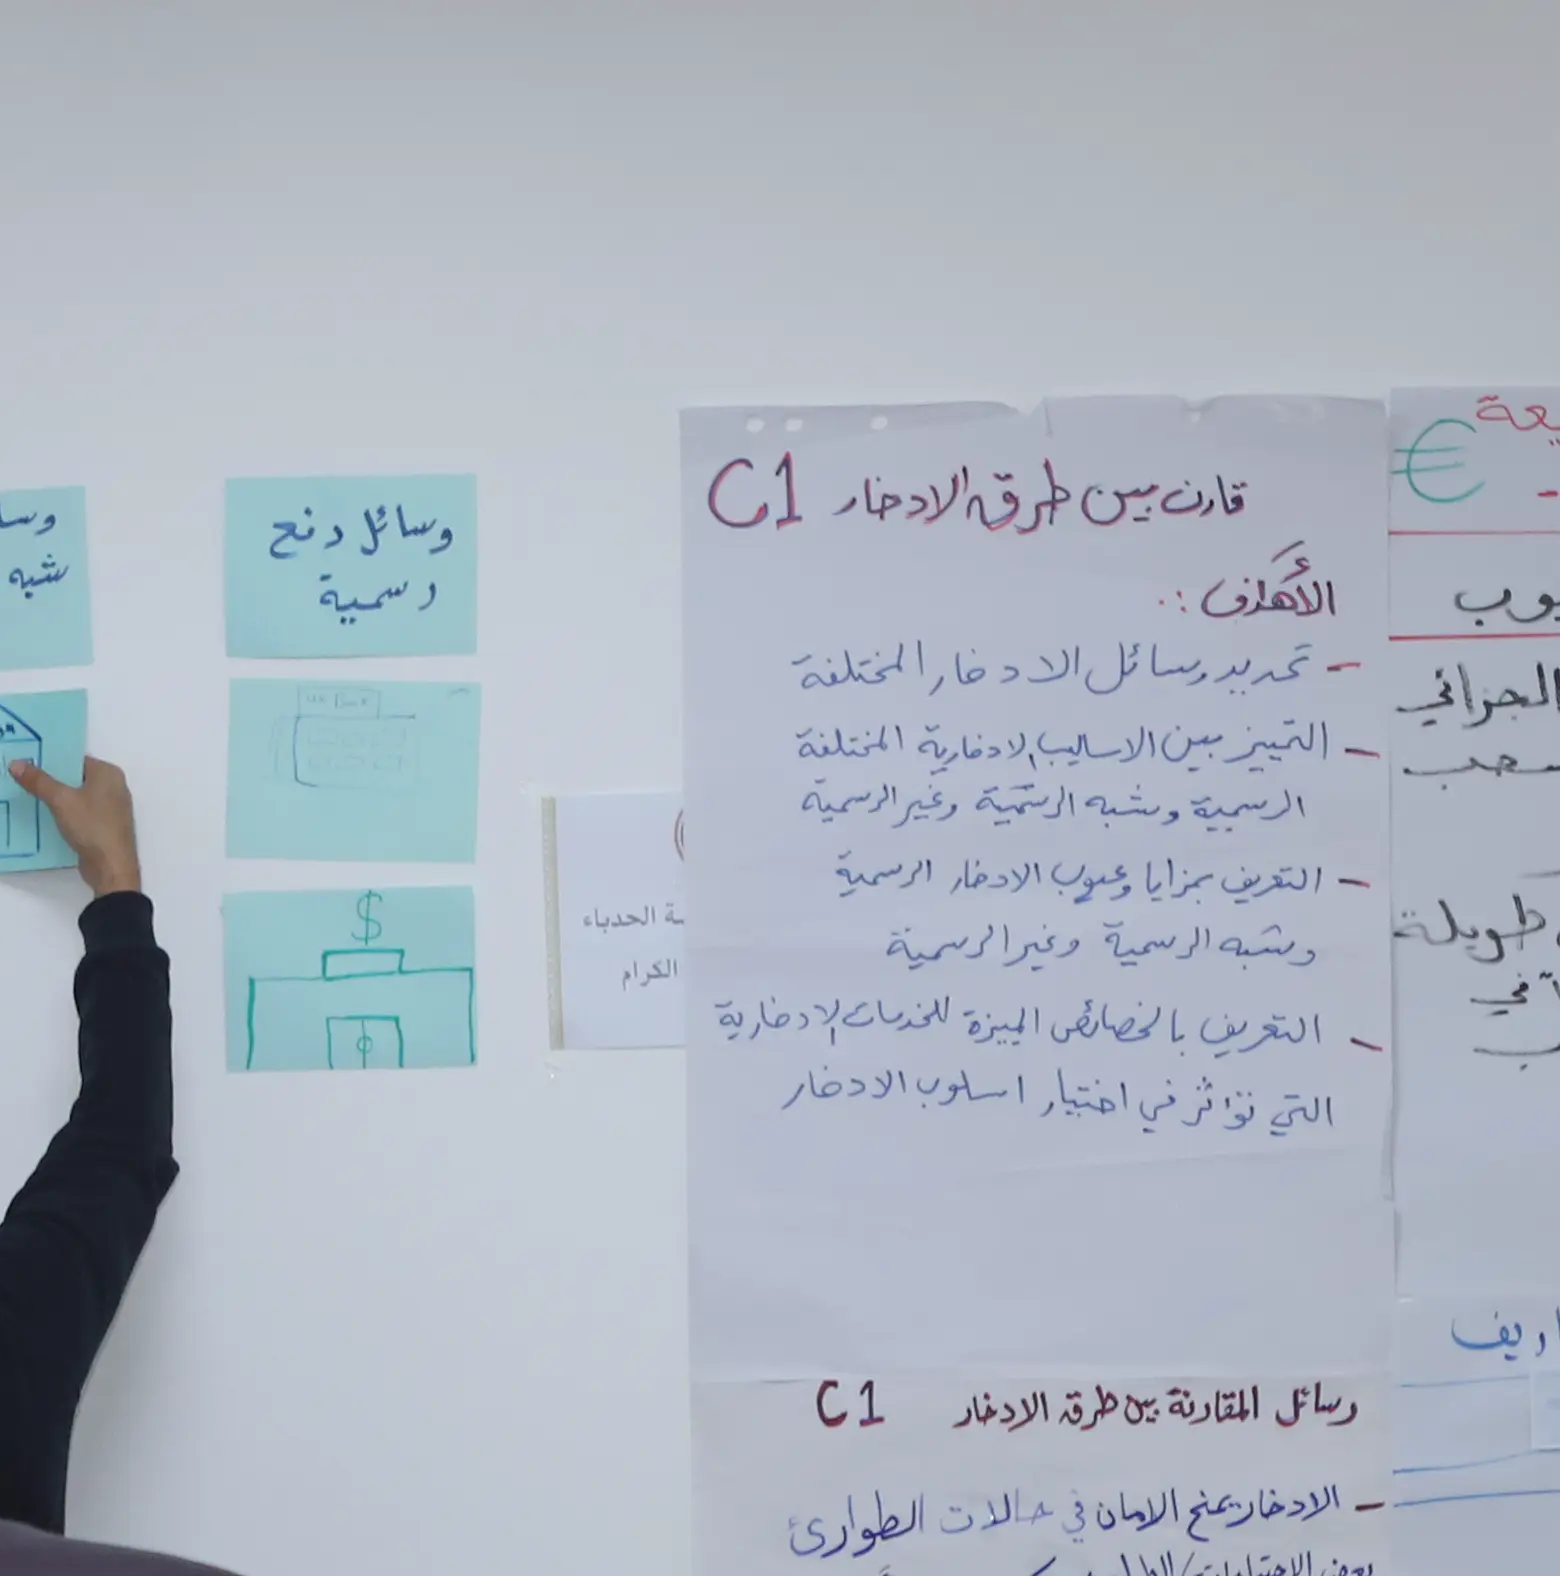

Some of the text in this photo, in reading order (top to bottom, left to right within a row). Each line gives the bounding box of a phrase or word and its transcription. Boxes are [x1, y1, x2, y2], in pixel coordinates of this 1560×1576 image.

[1081, 482, 1158, 527] بين
[1161, 475, 1249, 517] قارن
[360, 504, 453, 555] وسائل
[9, 554, 69, 599] شبه
[319, 574, 436, 625] رسمية
[792, 639, 923, 691] المختلفة
[1085, 641, 1208, 696] وسائل
[1215, 644, 1311, 694] تحديد
[795, 724, 902, 760] المختلفة
[1161, 730, 1223, 773] بين
[801, 778, 897, 823] الرسمية
[1085, 783, 1178, 829] وشبه
[1192, 789, 1305, 833] الرسمية
[835, 852, 932, 898] الرسمية
[949, 857, 1041, 895] الادخار
[1145, 858, 1213, 906] بمزايا
[1220, 866, 1321, 906] التعريف
[583, 905, 655, 934] الحدباء
[1393, 893, 1546, 964] طويلة
[1104, 921, 1210, 969] الرسمية
[1219, 924, 1316, 972] وشبه
[623, 958, 678, 992] الكرام
[1470, 973, 1528, 1016] في
[1200, 1013, 1320, 1053] التعريف
[780, 1067, 1333, 1136] التي في اختيار اسلوب الادخار
[952, 1391, 1048, 1432] الادخار
[1124, 1397, 1159, 1426] بين
[1169, 1385, 1260, 1426] المقارنة
[1062, 1489, 1084, 1543] في
[1095, 1489, 1178, 1532] الامان
[1184, 1493, 1235, 1542] يمنح
[1225, 1484, 1340, 1529] الادخار
